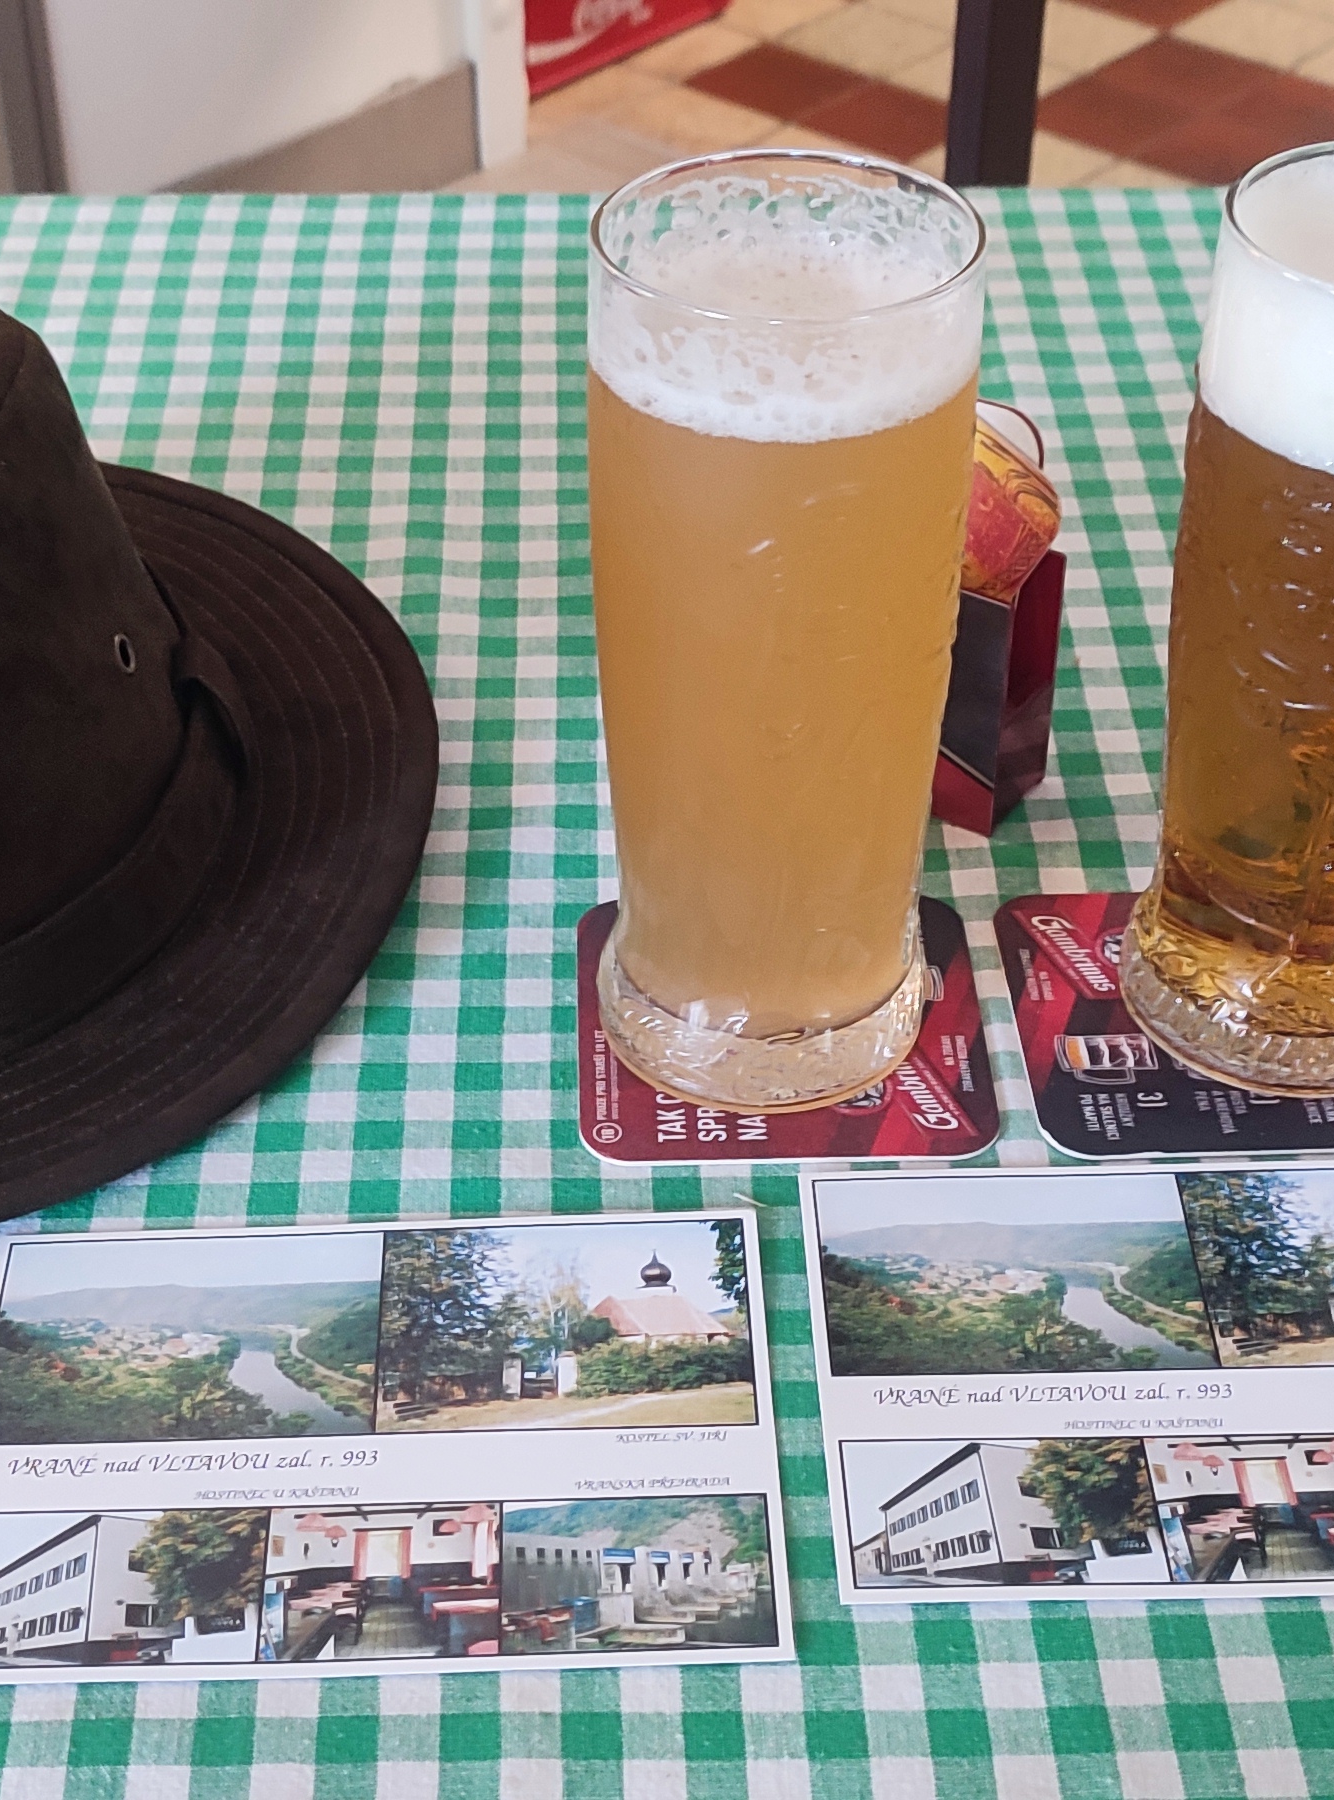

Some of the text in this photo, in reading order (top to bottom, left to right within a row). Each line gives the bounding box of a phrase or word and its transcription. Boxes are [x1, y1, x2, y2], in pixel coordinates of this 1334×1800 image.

[1030, 915, 1116, 992] Gambrinus
[655, 1107, 687, 1143] TAK
[736, 1115, 770, 1141] NA
[873, 1382, 1233, 1408] VRANÉ nad VLTAVOU zal. r. 993
[1140, 1418, 1151, 1429] U
[7, 1449, 379, 1478] VRANÉ nad VLTAVOU zal. r. 993
[272, 1488, 286, 1499] U
